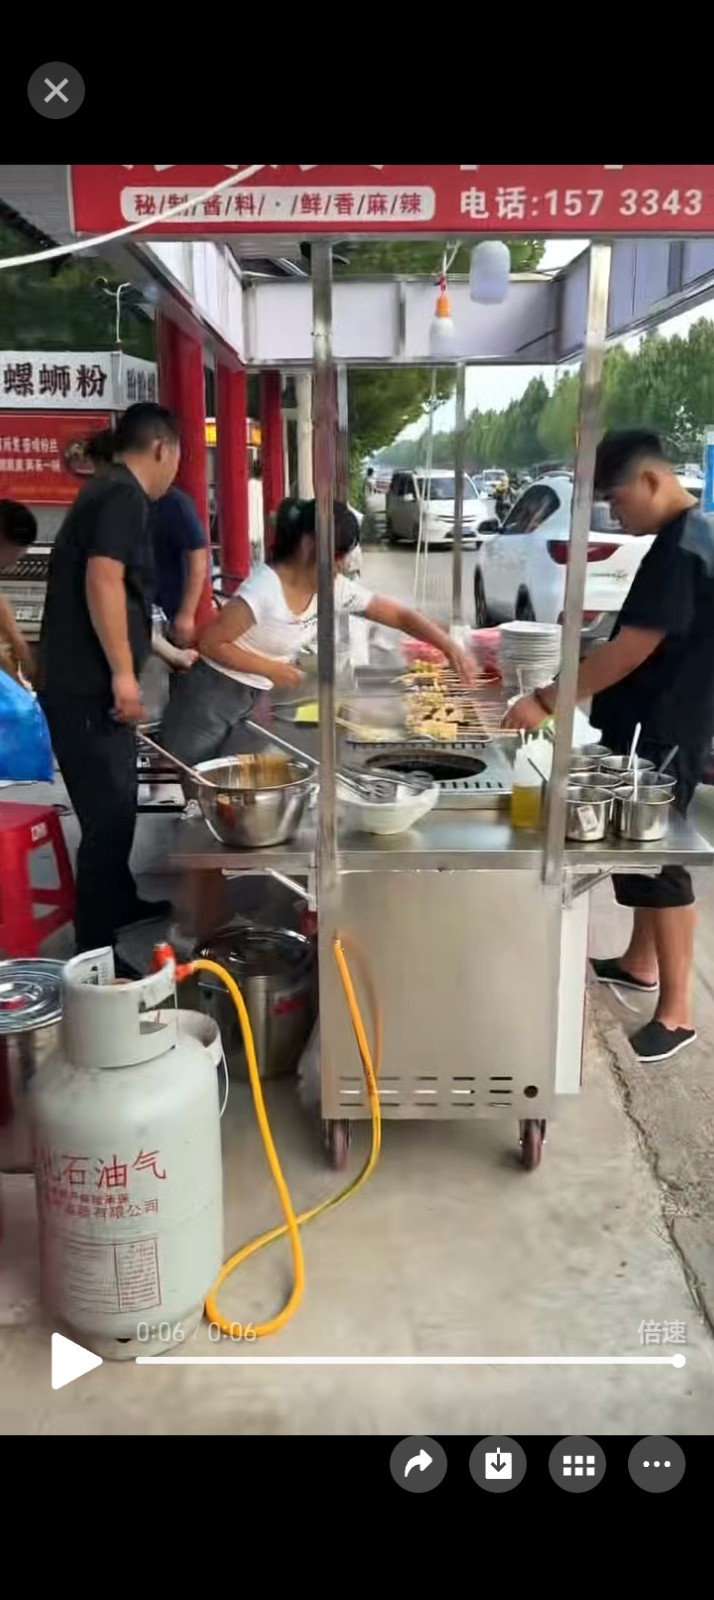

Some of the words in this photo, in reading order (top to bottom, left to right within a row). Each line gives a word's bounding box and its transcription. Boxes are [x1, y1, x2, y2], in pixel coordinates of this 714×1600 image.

[460, 186, 604, 219] 电话:157
[619, 188, 703, 216] 3343
[3, 361, 108, 398] 螺蛳粉
